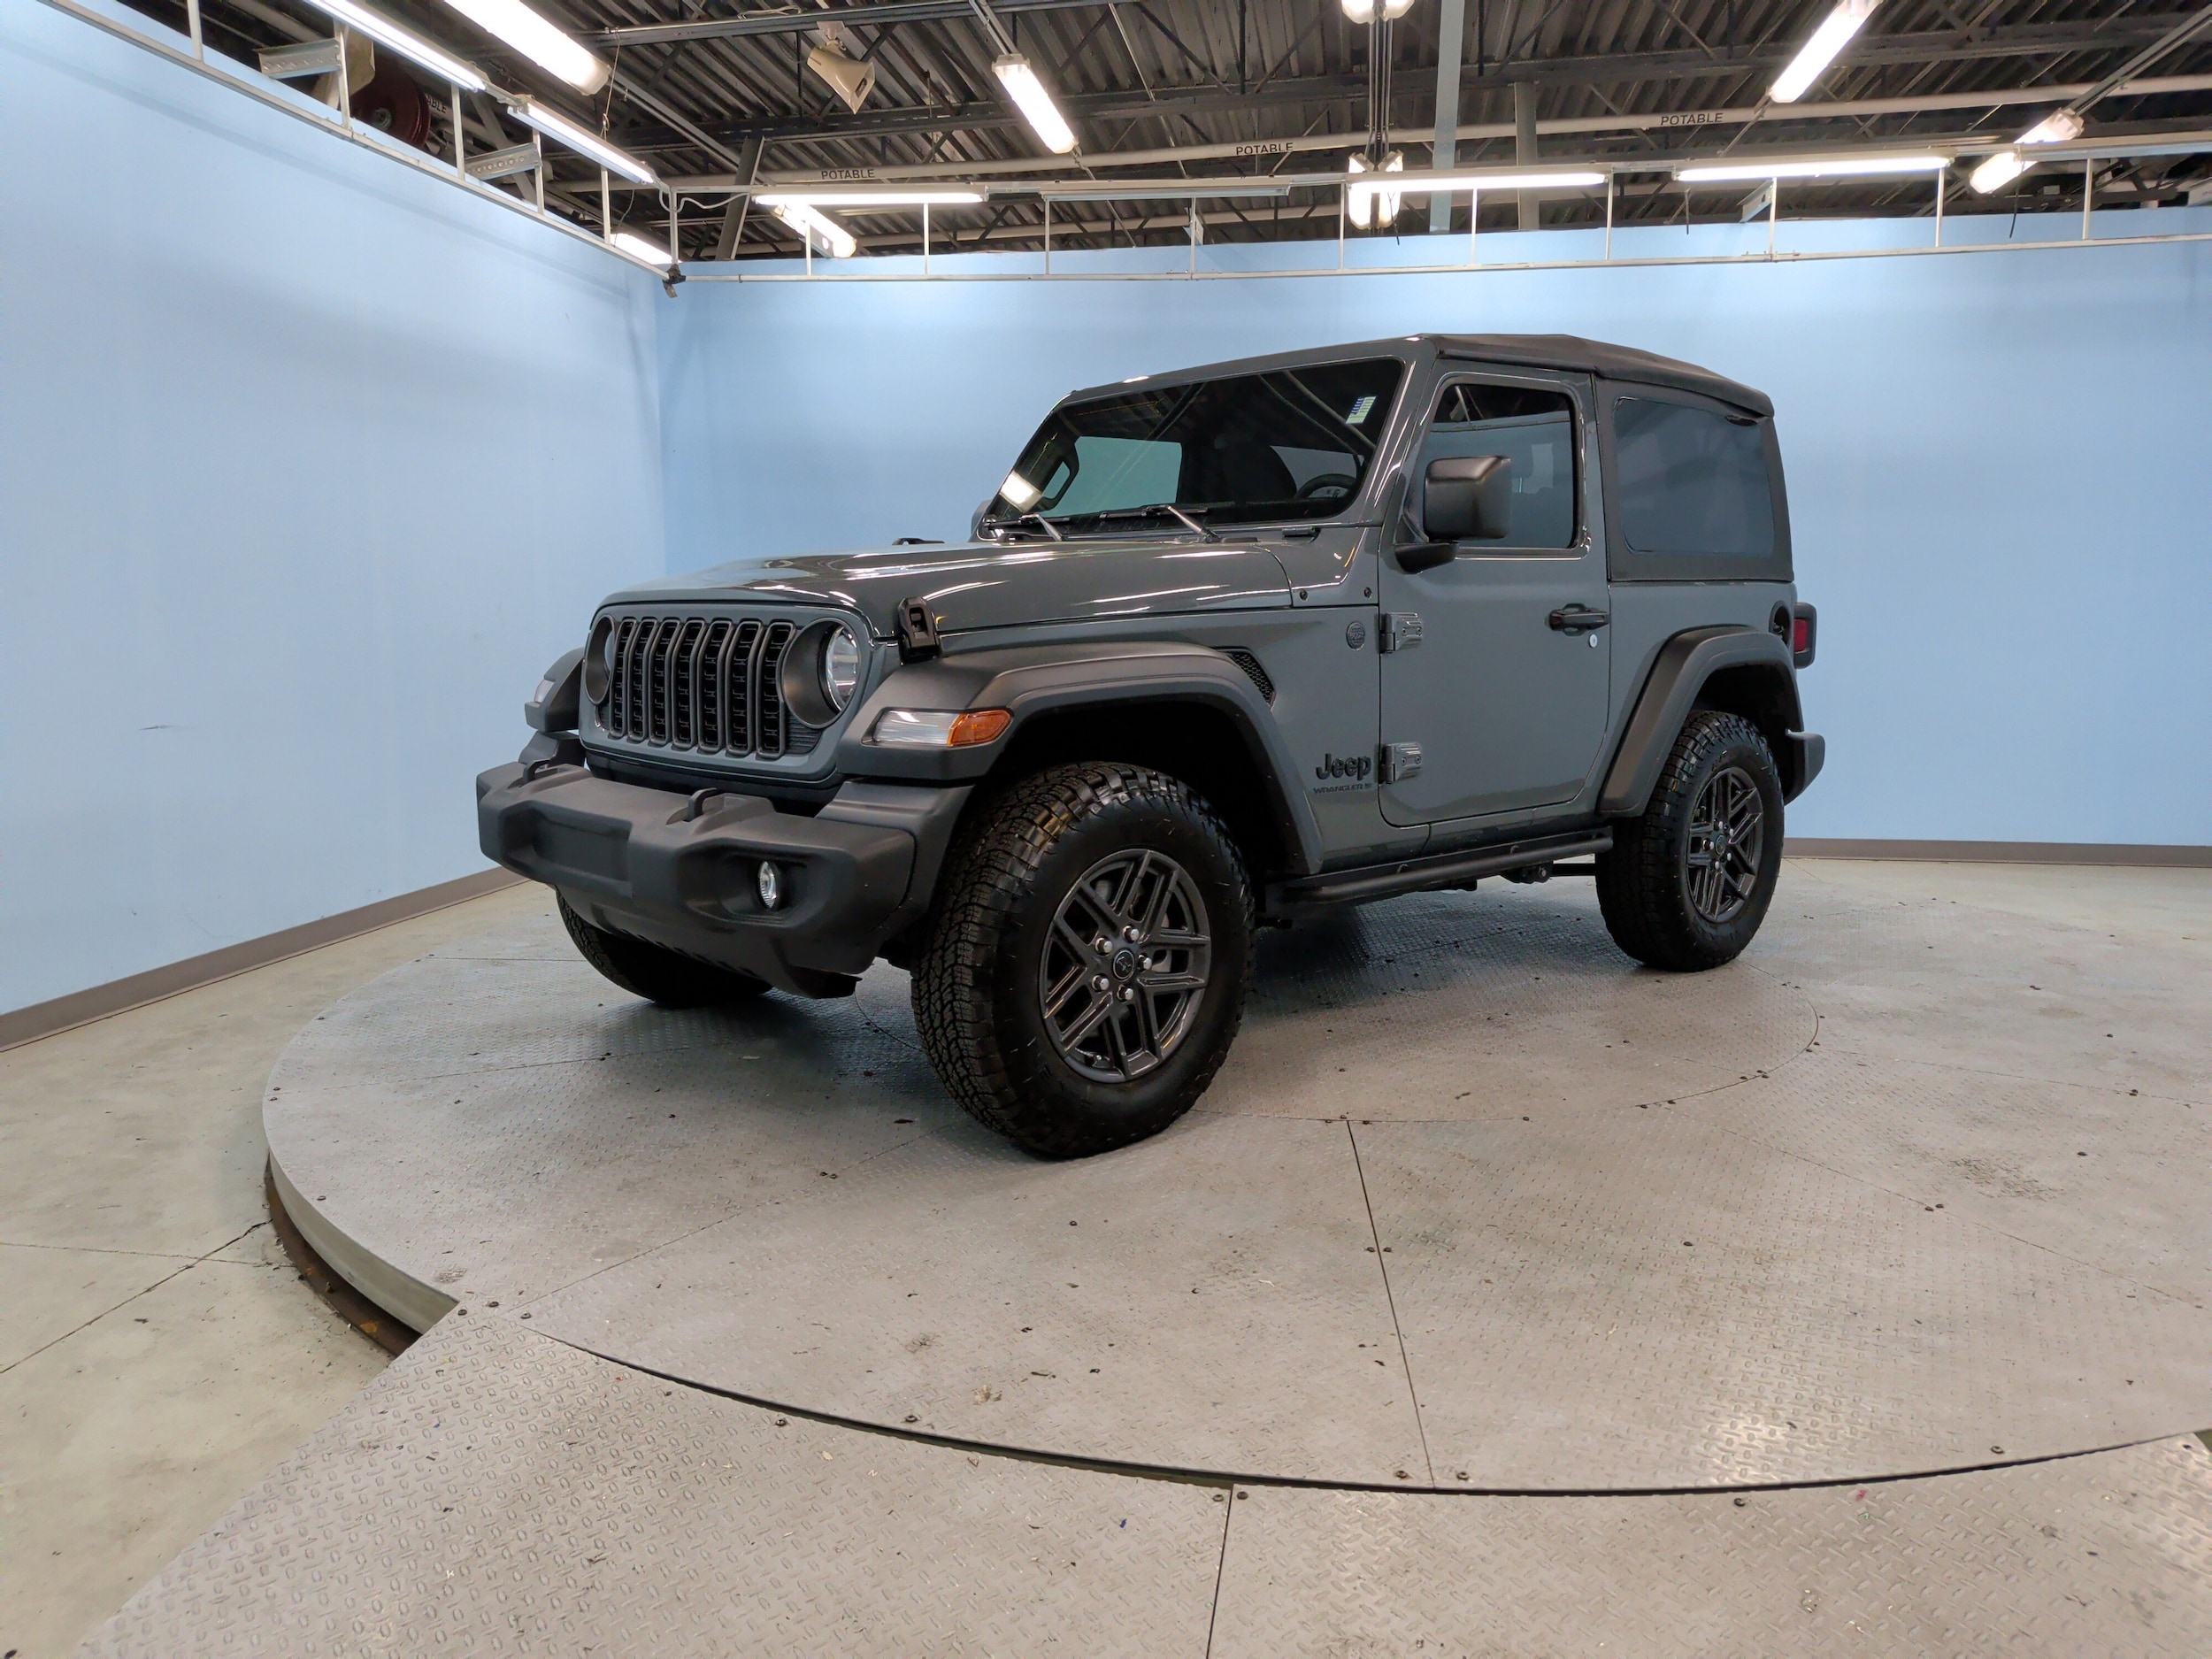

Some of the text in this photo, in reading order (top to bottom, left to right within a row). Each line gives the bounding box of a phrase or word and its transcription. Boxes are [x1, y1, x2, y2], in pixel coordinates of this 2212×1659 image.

[1661, 112, 1724, 126] POTABLE
[1236, 142, 1293, 155] POTABLE
[821, 169, 875, 180] POTABLE
[1316, 753, 1371, 780] Jeep
